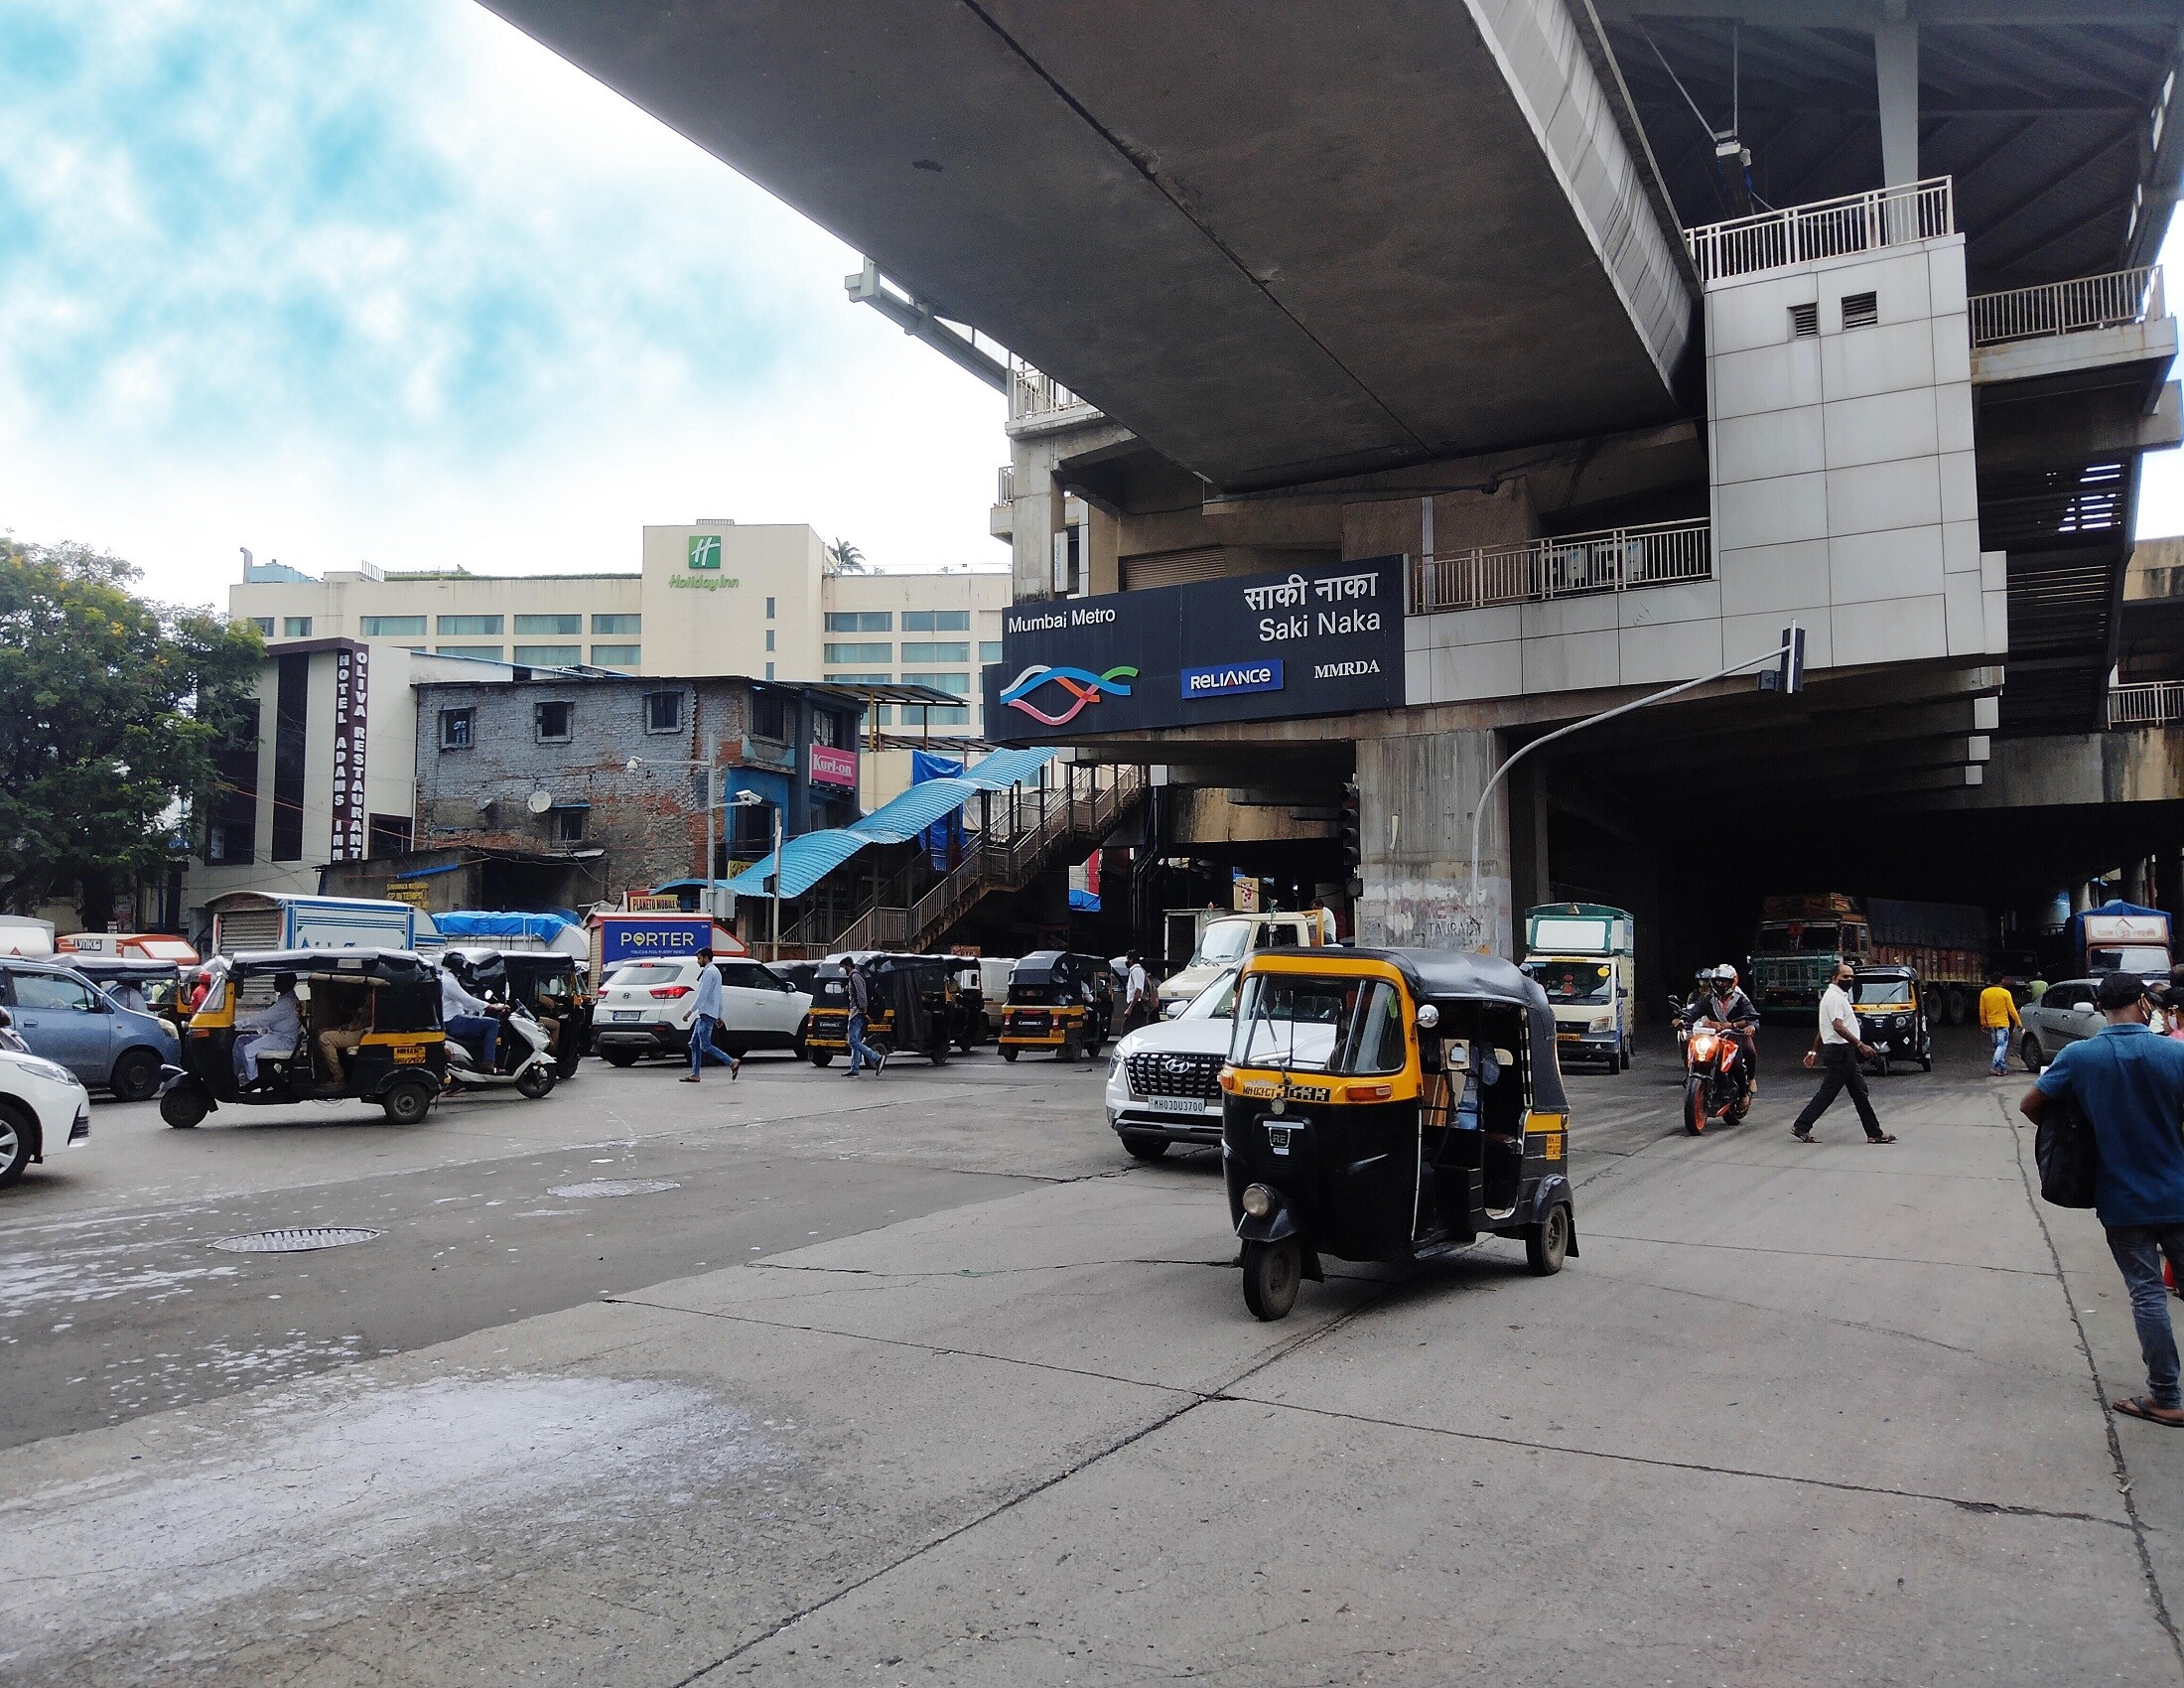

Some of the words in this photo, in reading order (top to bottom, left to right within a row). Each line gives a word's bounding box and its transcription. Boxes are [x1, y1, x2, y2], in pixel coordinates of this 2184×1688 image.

[668, 574, 718, 592] Holiday
[719, 574, 741, 589] Inn
[1243, 573, 1309, 611] साकी
[1313, 572, 1379, 603] नाका
[1008, 611, 1068, 633] Mumbai
[1071, 608, 1116, 627] Metro
[1259, 614, 1308, 642] Saki
[1317, 608, 1381, 635] Naka
[1313, 659, 1381, 679] MMRDA
[337, 654, 349, 724] HOTEL
[353, 651, 368, 717] OLIVA
[334, 736, 347, 806] ADAMS
[812, 754, 853, 775] Kurl-on
[348, 726, 366, 859] RESTAURANT
[332, 820, 343, 861] INN
[656, 898, 676, 910] MOBILE
[620, 931, 695, 947] PORTER
[1154, 1099, 1203, 1112] MH03DU3700
[1273, 1134, 1287, 1144] RE
